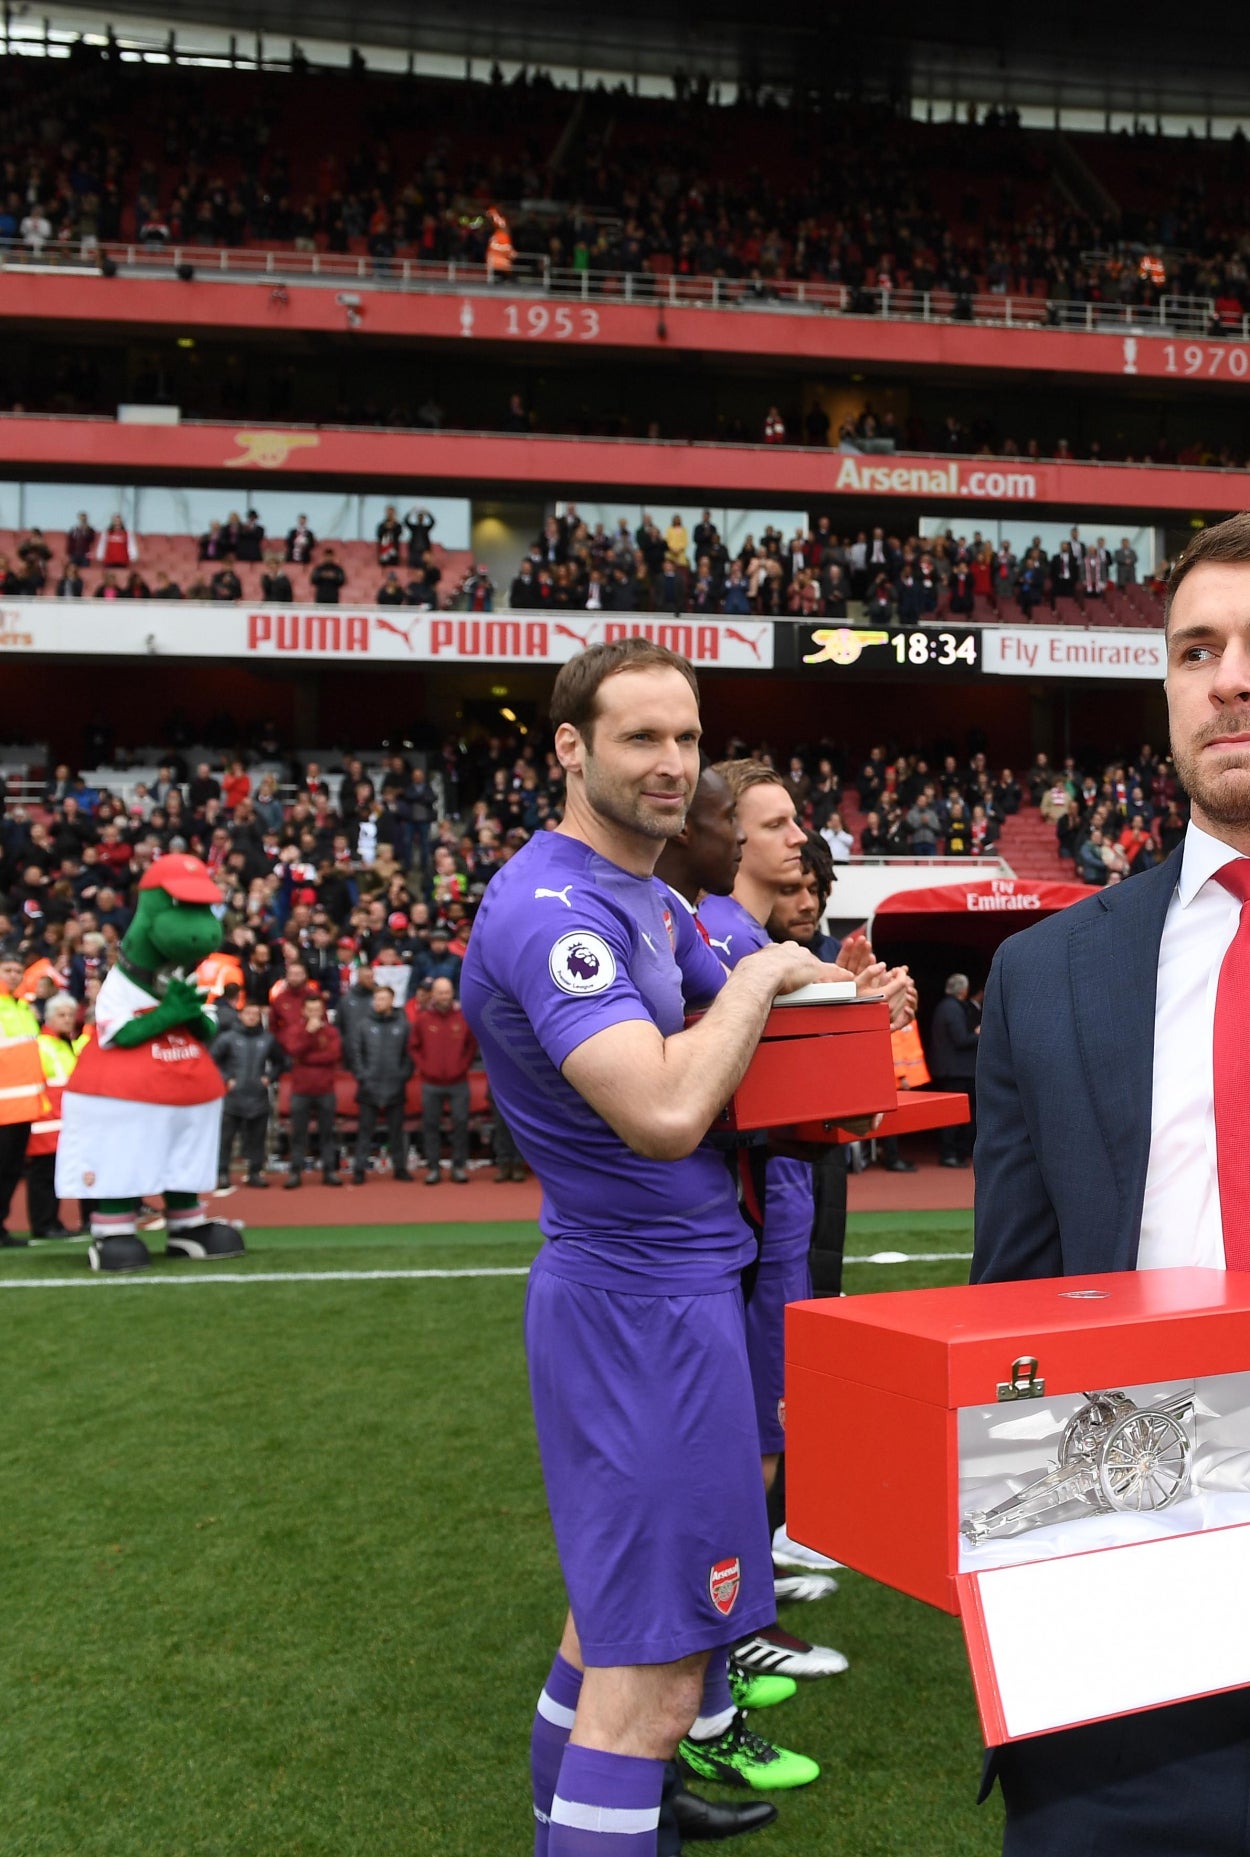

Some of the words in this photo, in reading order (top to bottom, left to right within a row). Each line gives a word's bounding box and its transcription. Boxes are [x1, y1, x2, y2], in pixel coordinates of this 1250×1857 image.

[504, 304, 600, 340] 1953
[1163, 344, 1249, 377] 1970
[836, 457, 1036, 499] Arsenal.com
[247, 615, 371, 651] PUMA
[430, 620, 549, 657] PUMA
[891, 632, 978, 665] 18:34
[1001, 636, 1038, 668] Fly
[1050, 639, 1159, 666] Emirates
[966, 892, 1042, 911] Emirates
